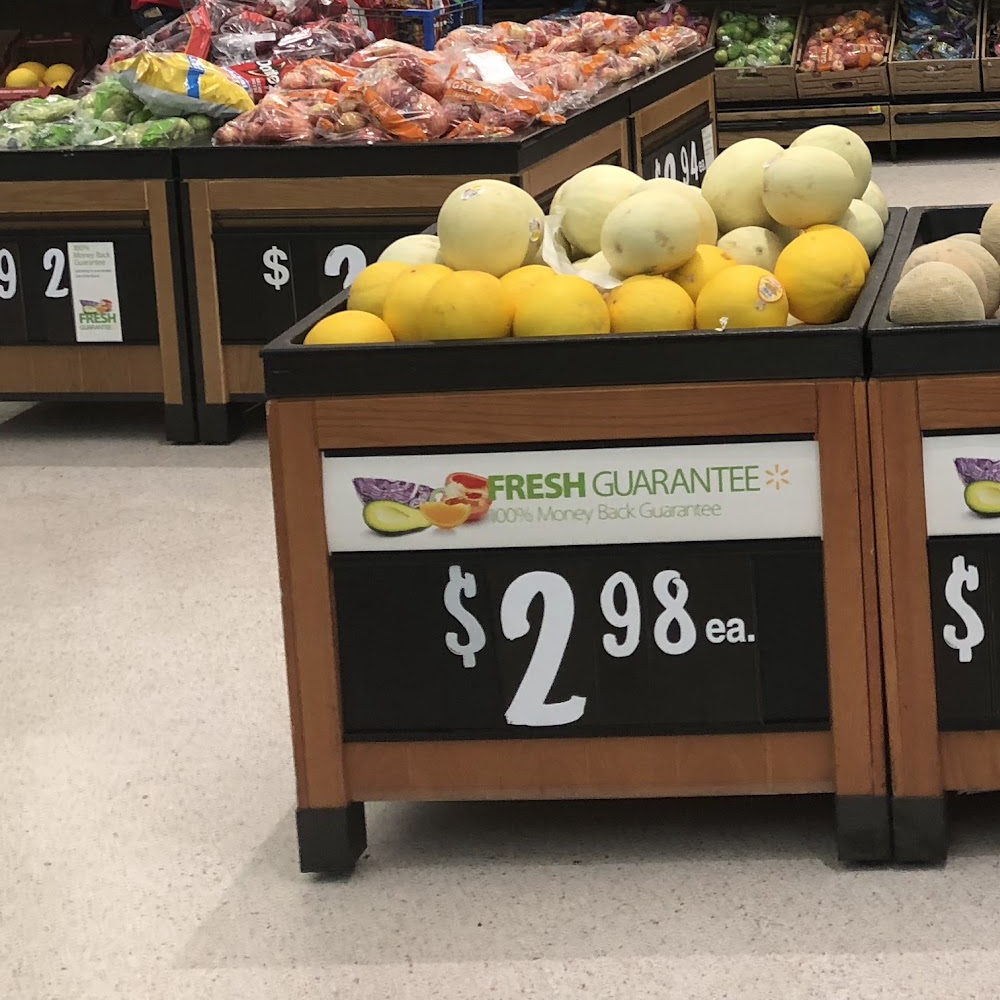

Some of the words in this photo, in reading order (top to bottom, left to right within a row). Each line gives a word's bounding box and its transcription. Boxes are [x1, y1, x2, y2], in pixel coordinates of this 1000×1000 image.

[452, 81, 482, 95] GALA
[79, 313, 117, 324] FRESH
[487, 471, 586, 501] FRESH
[592, 465, 760, 498] GUARANTEE
[537, 506, 594, 525] Money
[598, 502, 634, 520] Back
[638, 501, 722, 519] Guarantee
[705, 616, 756, 644] ea.
